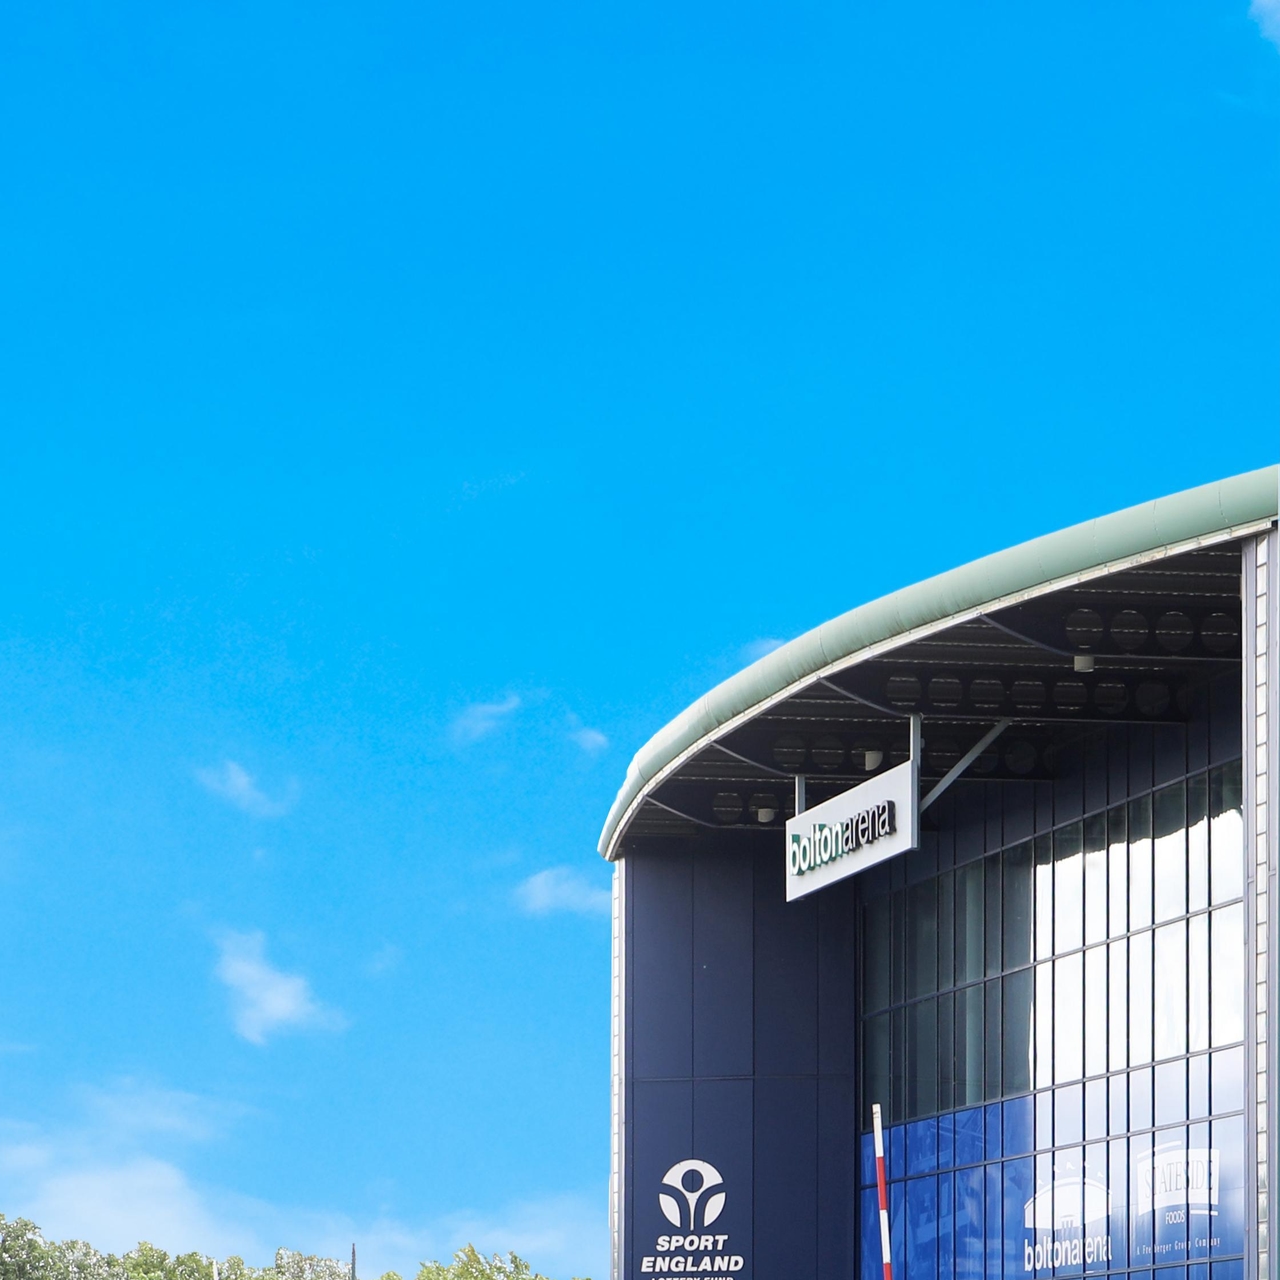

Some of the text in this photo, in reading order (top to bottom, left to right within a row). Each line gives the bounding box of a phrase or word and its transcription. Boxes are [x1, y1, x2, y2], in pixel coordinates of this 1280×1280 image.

[790, 800, 896, 876] boltonarena
[1166, 1210, 1184, 1224] FOODS
[656, 1235, 728, 1251] SPORT
[1143, 1244, 1171, 1254] Freberger
[1025, 1234, 1112, 1271] boltonarena
[641, 1256, 744, 1272] ENGLAND
